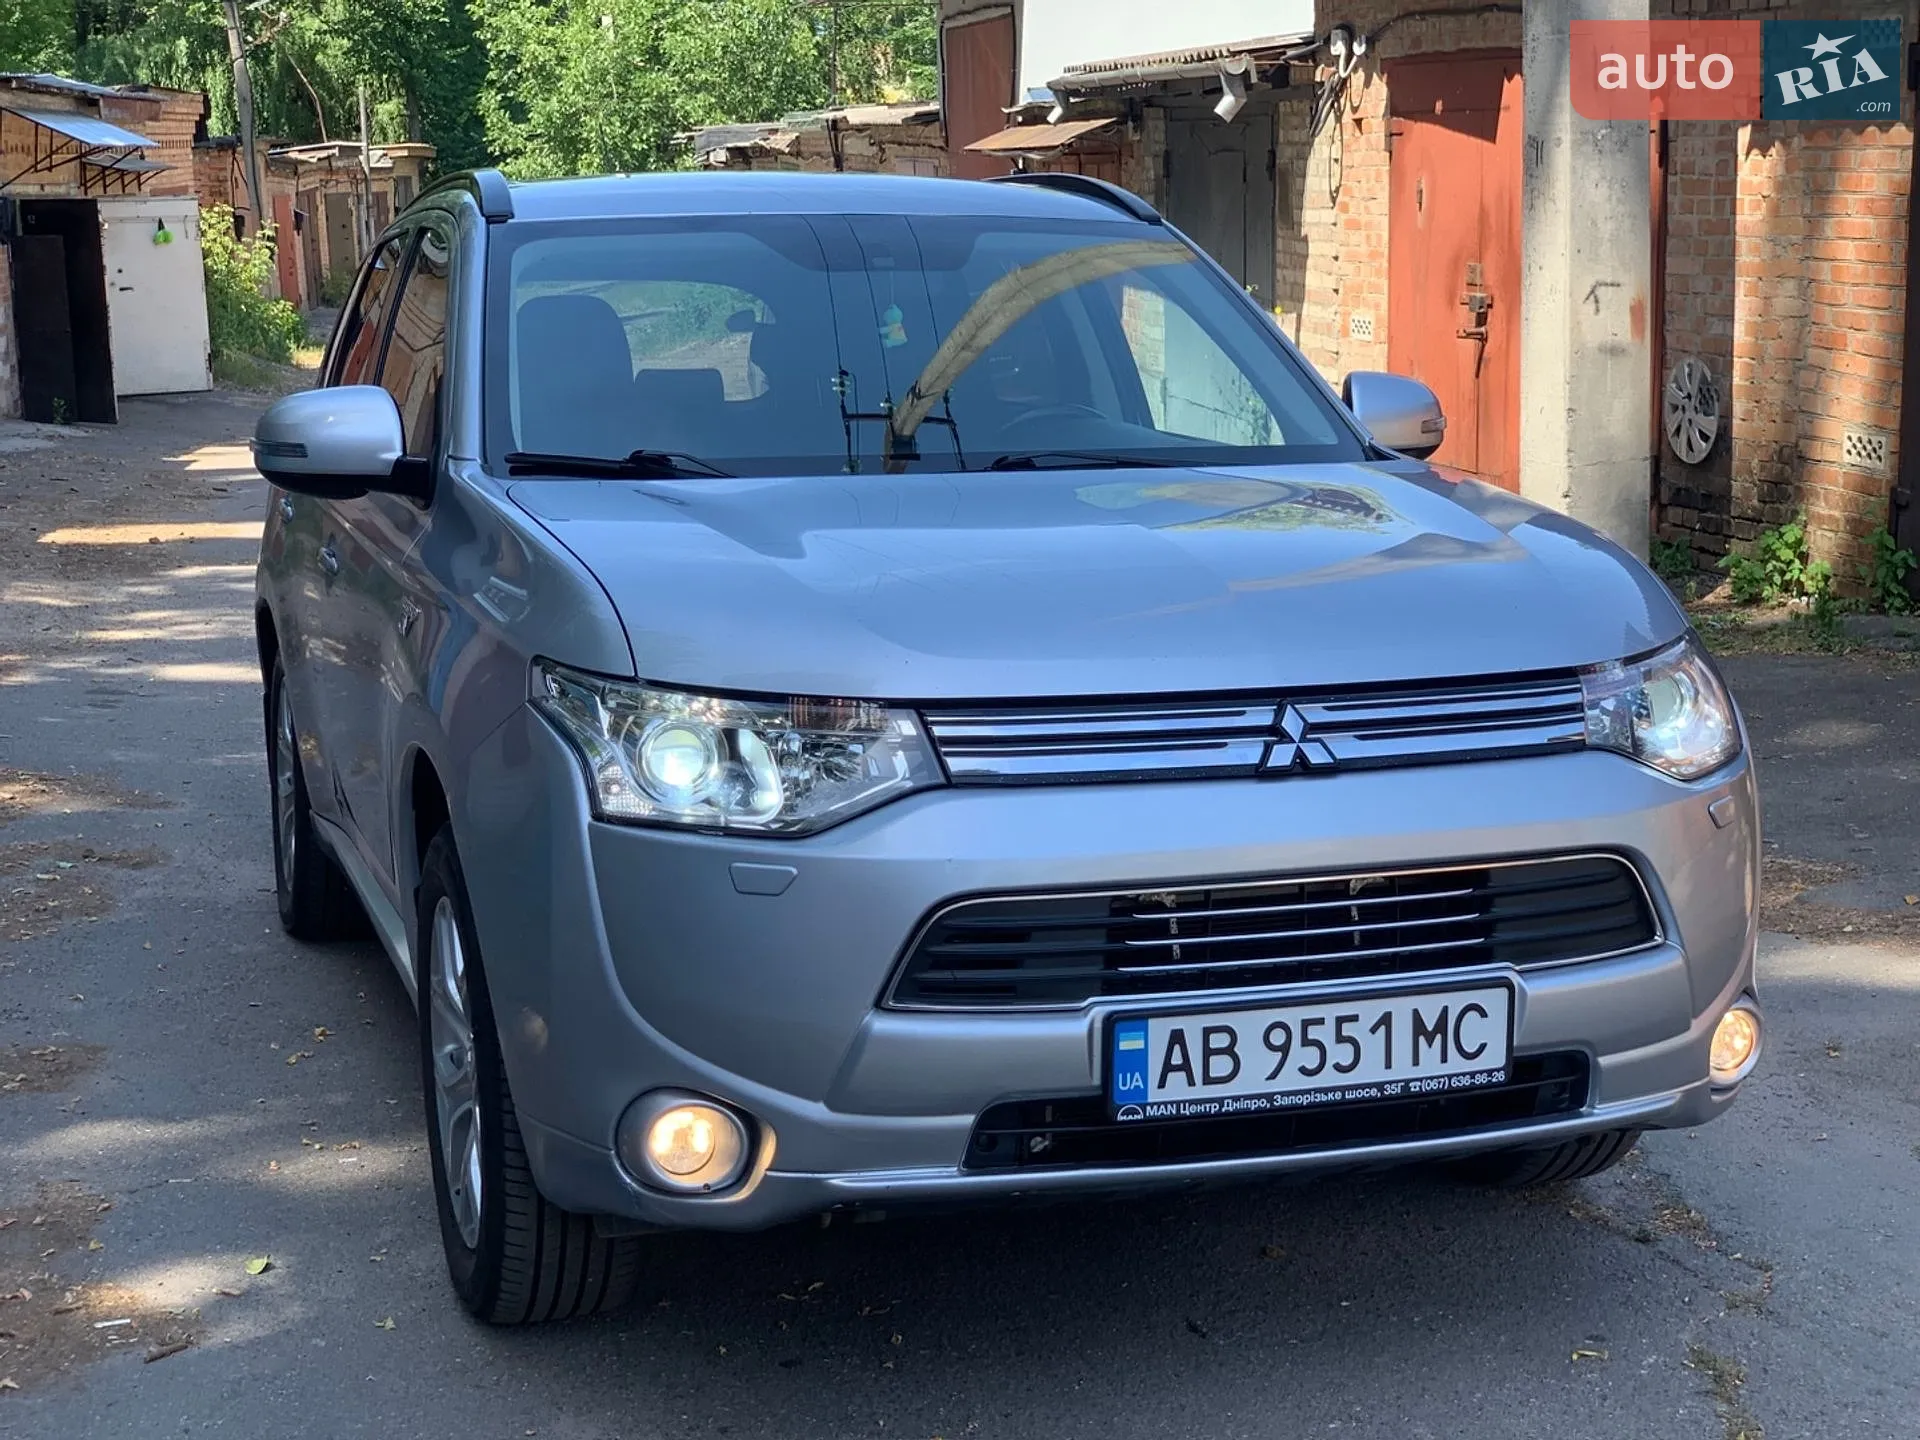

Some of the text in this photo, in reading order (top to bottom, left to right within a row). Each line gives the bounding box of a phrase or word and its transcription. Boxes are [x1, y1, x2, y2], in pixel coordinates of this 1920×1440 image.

[1156, 1002, 1489, 1090] AB 9551 MC
[1118, 1073, 1144, 1090] UA
[1146, 1103, 1177, 1117] MAN
[1180, 1102, 1219, 1115] Центр
[1221, 1097, 1271, 1113] Дніпро,
[1273, 1090, 1342, 1105] Запорізьке
